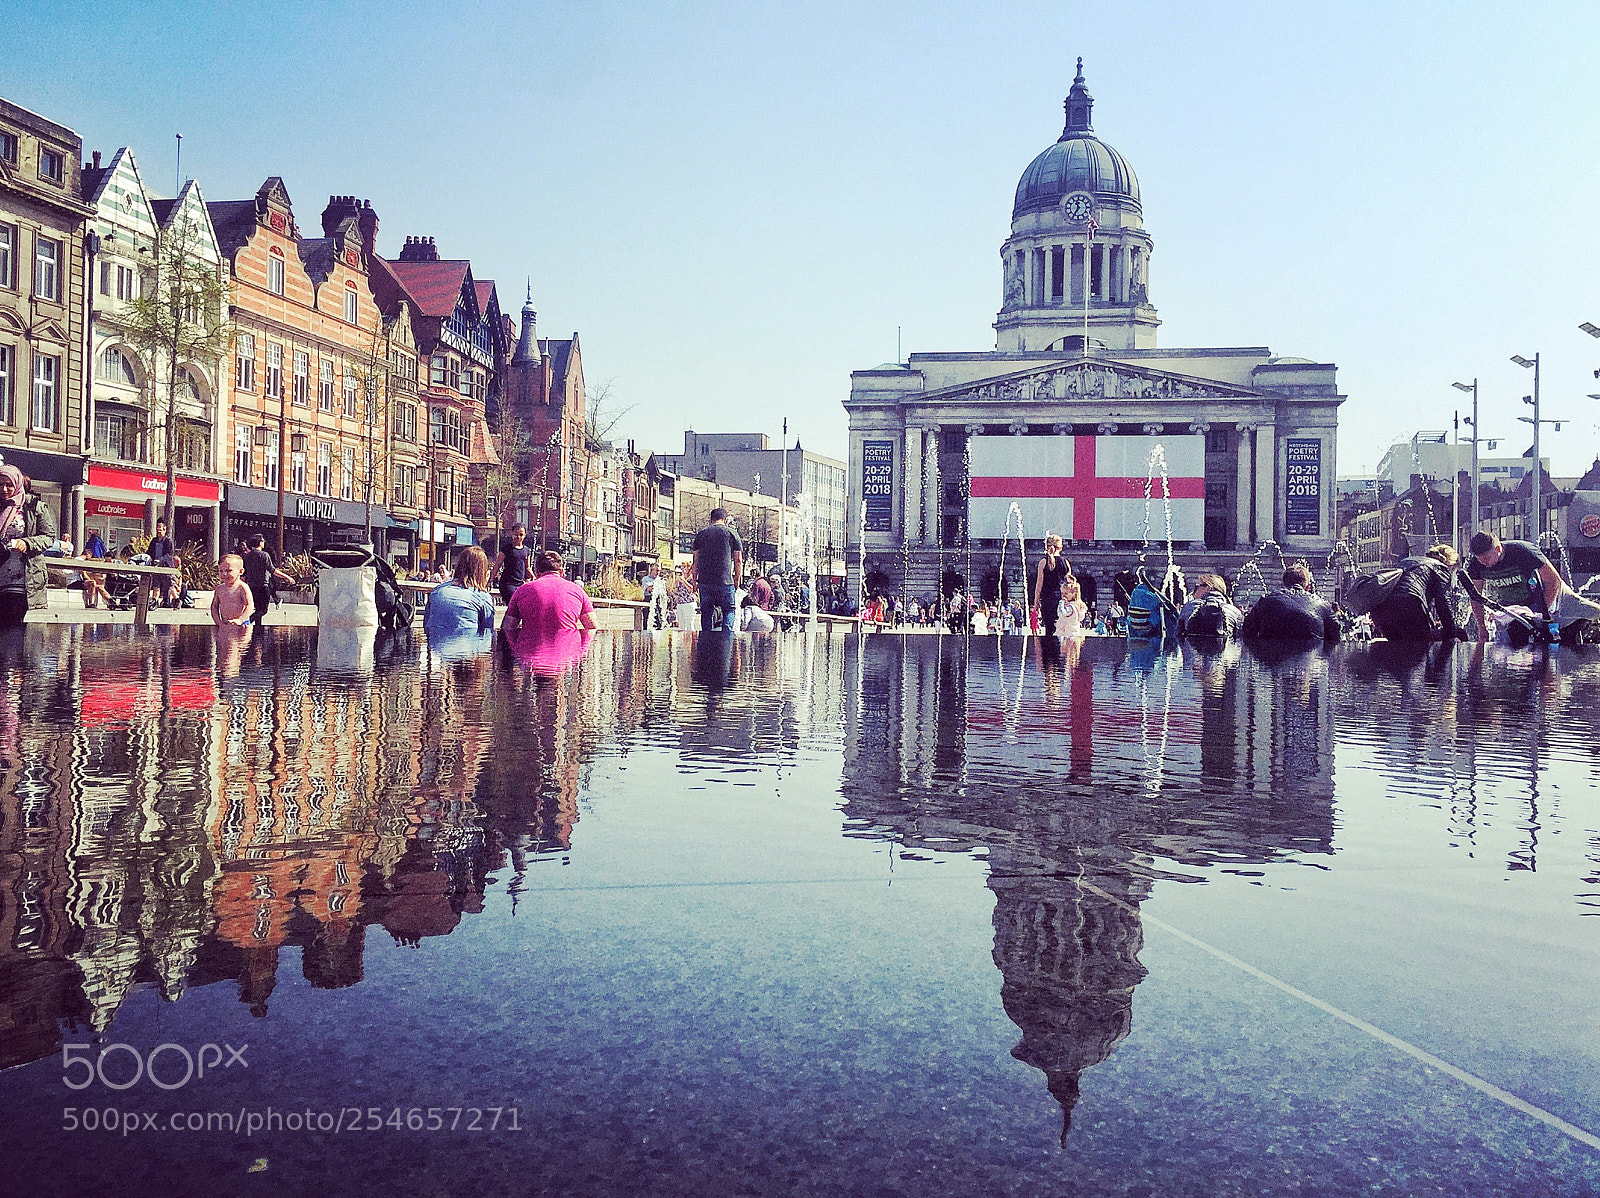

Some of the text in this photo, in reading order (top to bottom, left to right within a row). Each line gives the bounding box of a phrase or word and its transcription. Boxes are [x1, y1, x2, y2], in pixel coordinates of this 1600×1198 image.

[1288, 447, 1319, 455] POETRY
[865, 466, 891, 475] 20-29
[1288, 465, 1319, 475] 20-29
[141, 477, 176, 491] Ladbro
[864, 475, 892, 484] APRIL
[1288, 475, 1319, 484] APRIL
[864, 484, 891, 494] 2018
[1288, 484, 1318, 496] 2018
[98, 504, 127, 515] Ladbrokes
[299, 500, 336, 520] MOD PIZZA
[261, 521, 278, 529] PIZZ
